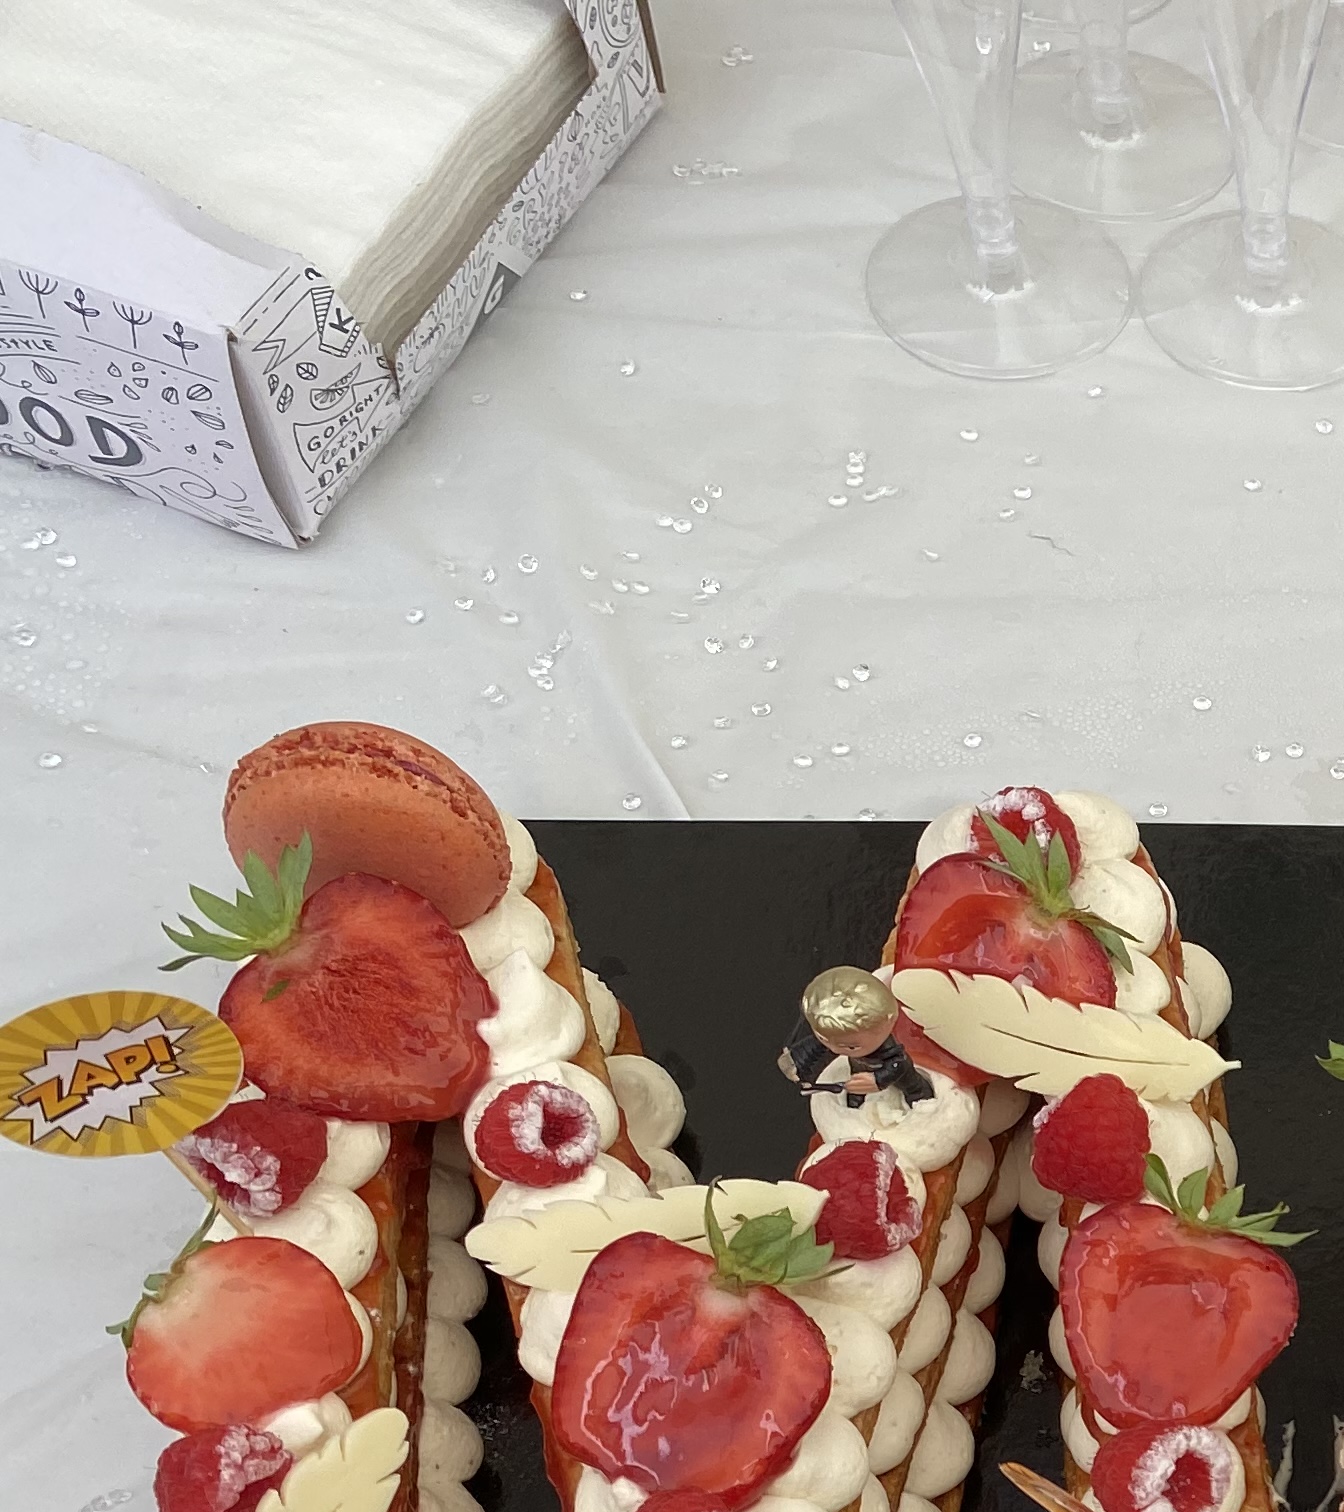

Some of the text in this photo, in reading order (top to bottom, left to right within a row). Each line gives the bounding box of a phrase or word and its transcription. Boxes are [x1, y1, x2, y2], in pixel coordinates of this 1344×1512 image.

[0, 396, 143, 467] OD
[317, 425, 384, 488] DRINK
[18, 1034, 180, 1123] ZAP!
